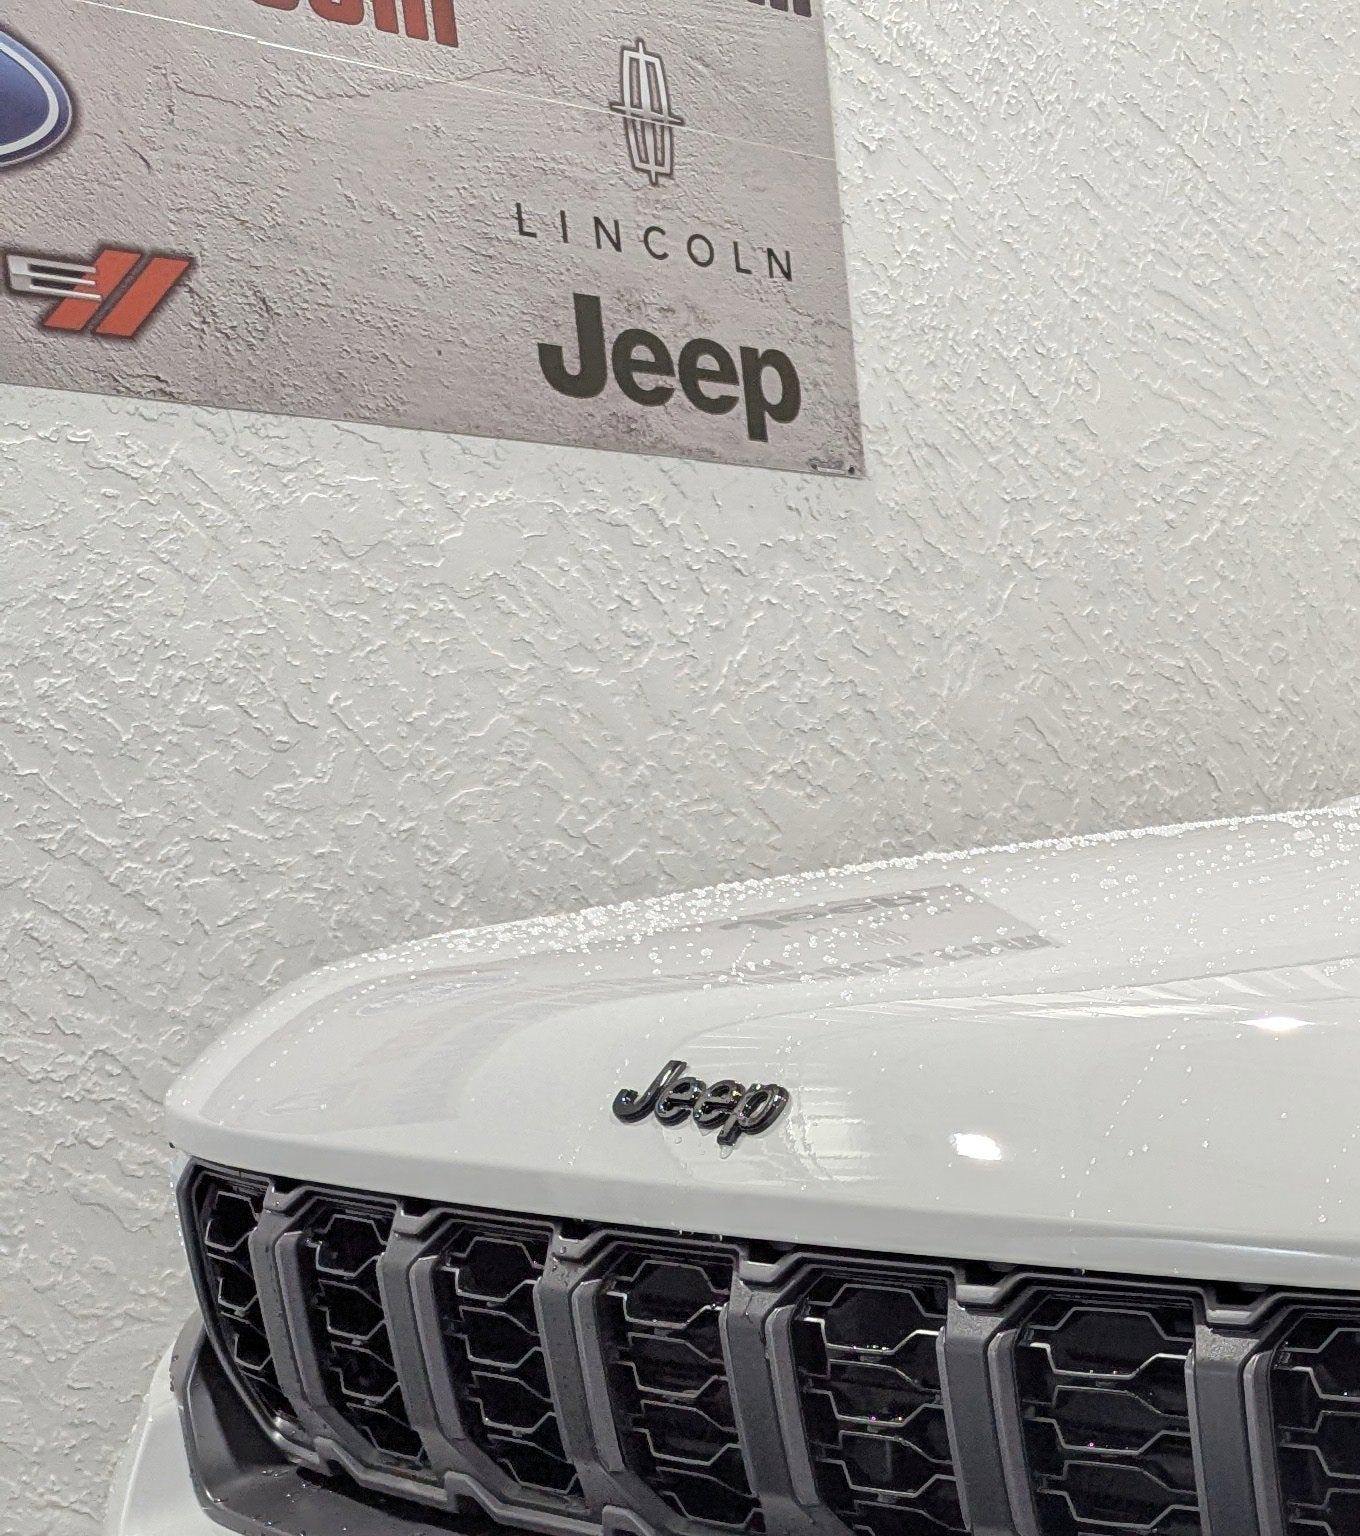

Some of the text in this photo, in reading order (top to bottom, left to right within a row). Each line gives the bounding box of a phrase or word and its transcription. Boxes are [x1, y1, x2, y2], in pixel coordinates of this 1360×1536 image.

[515, 202, 792, 282] LINCOLN
[537, 292, 801, 443] Jeep
[612, 1060, 790, 1146] Jeep
